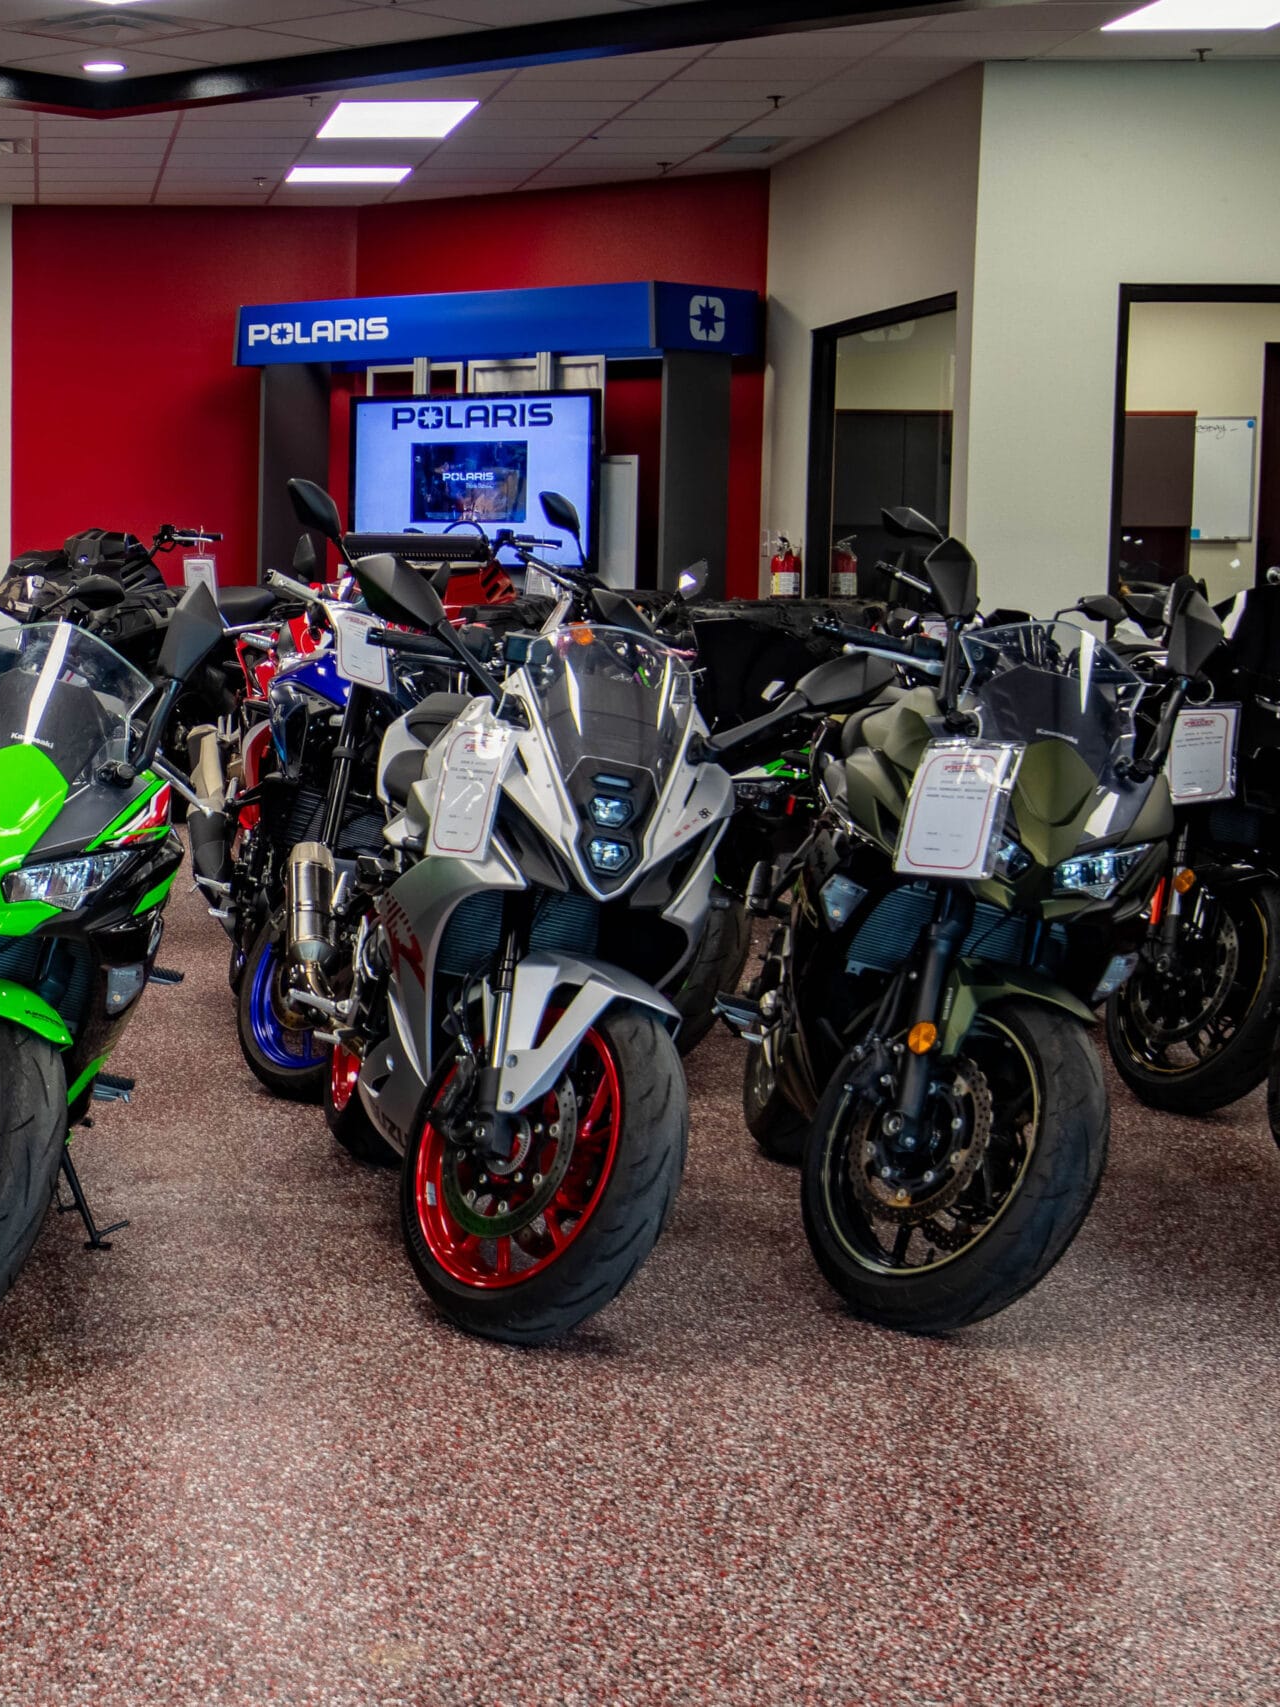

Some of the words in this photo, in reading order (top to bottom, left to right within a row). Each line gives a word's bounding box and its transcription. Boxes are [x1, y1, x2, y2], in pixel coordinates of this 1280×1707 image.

[248, 316, 389, 346] POLARIS
[391, 402, 553, 430] POLARIS
[442, 472, 494, 481] POLARIS
[10, 732, 54, 749] Kasaki
